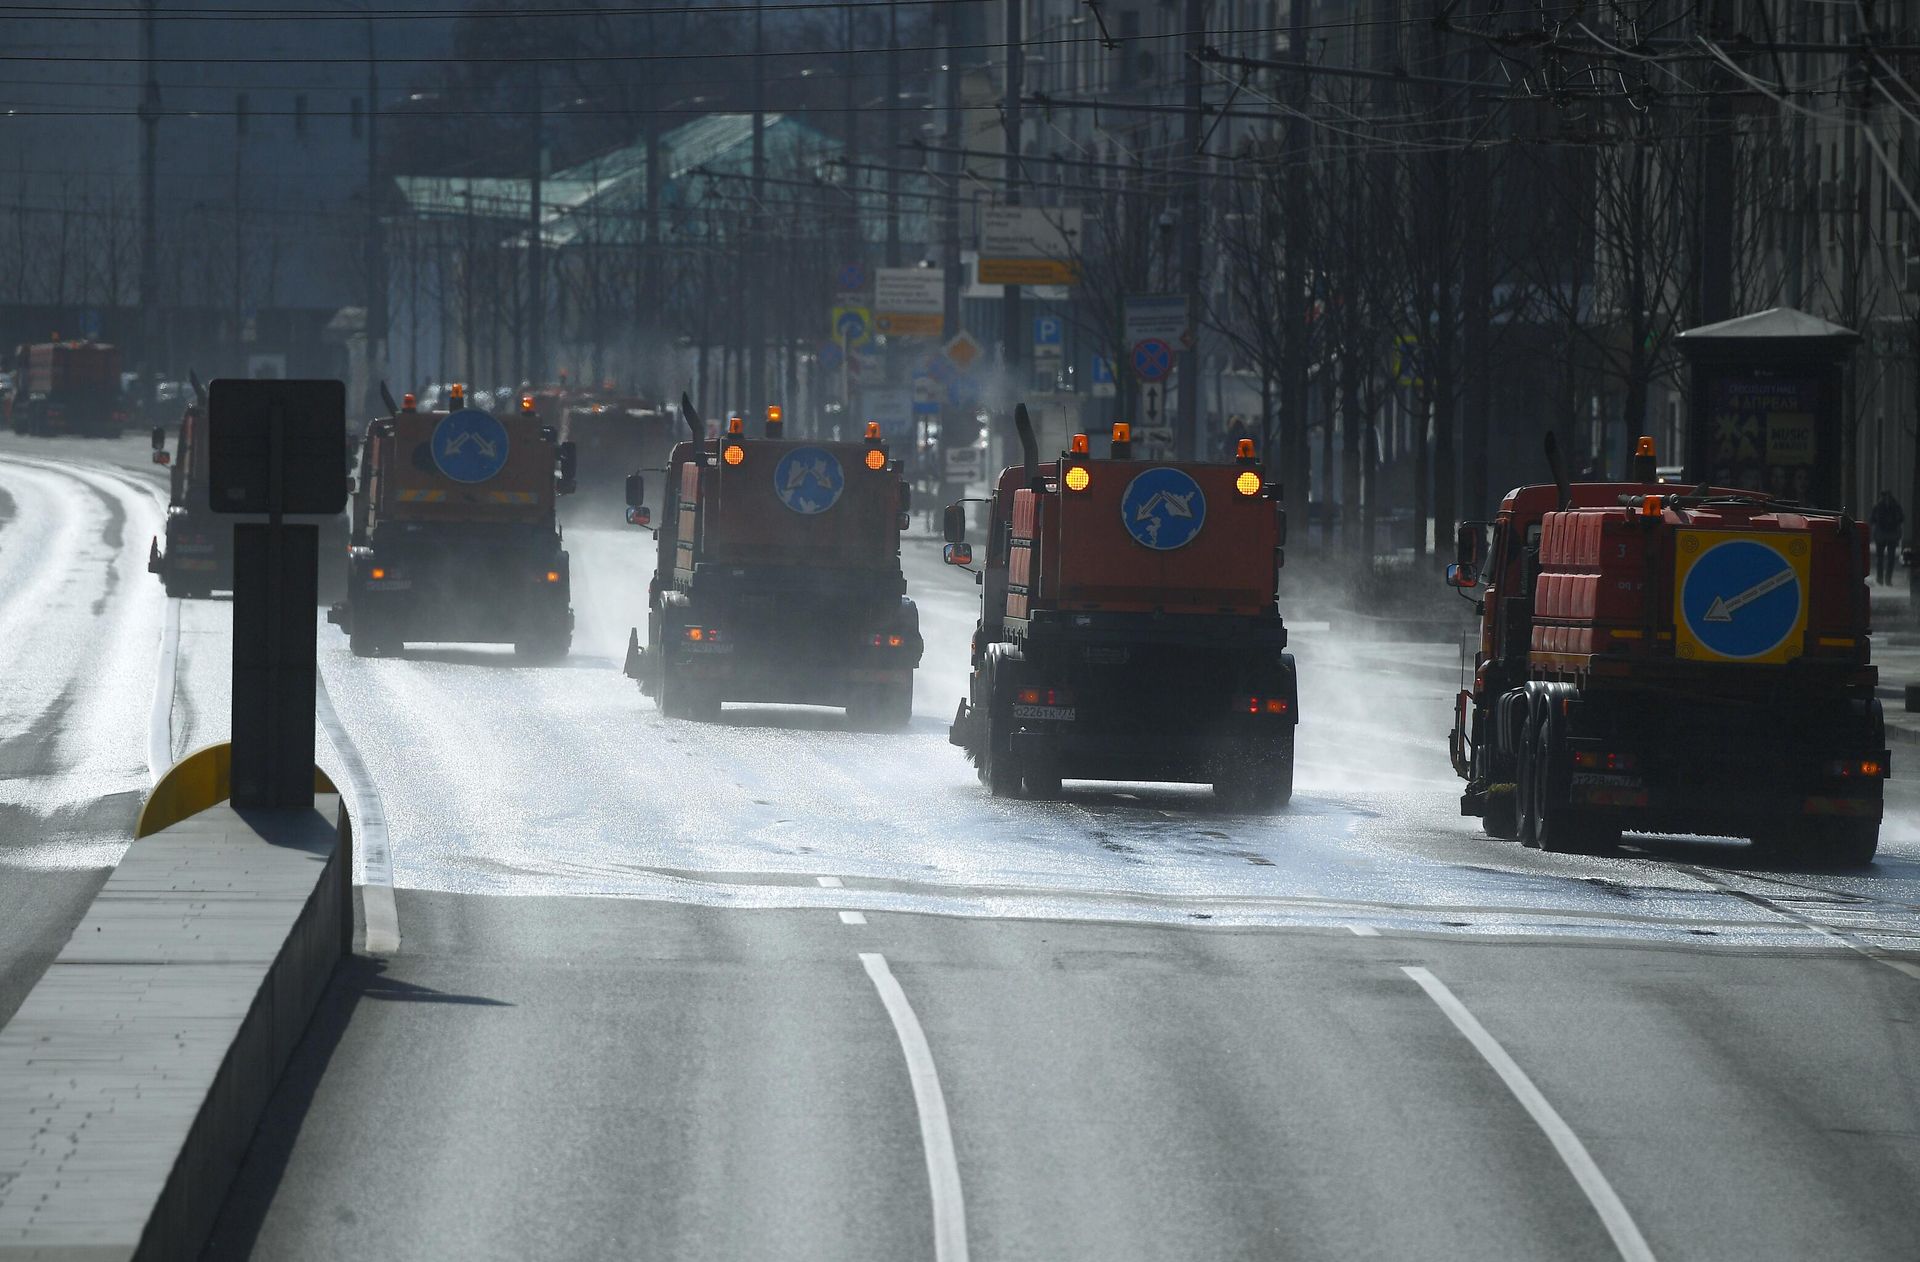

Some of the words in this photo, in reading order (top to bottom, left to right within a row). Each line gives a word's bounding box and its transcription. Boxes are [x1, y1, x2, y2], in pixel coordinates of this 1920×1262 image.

[1040, 320, 1056, 342] P
[1743, 395, 1799, 409] АПРЕЛЯ
[1771, 426, 1809, 441] MUSIC
